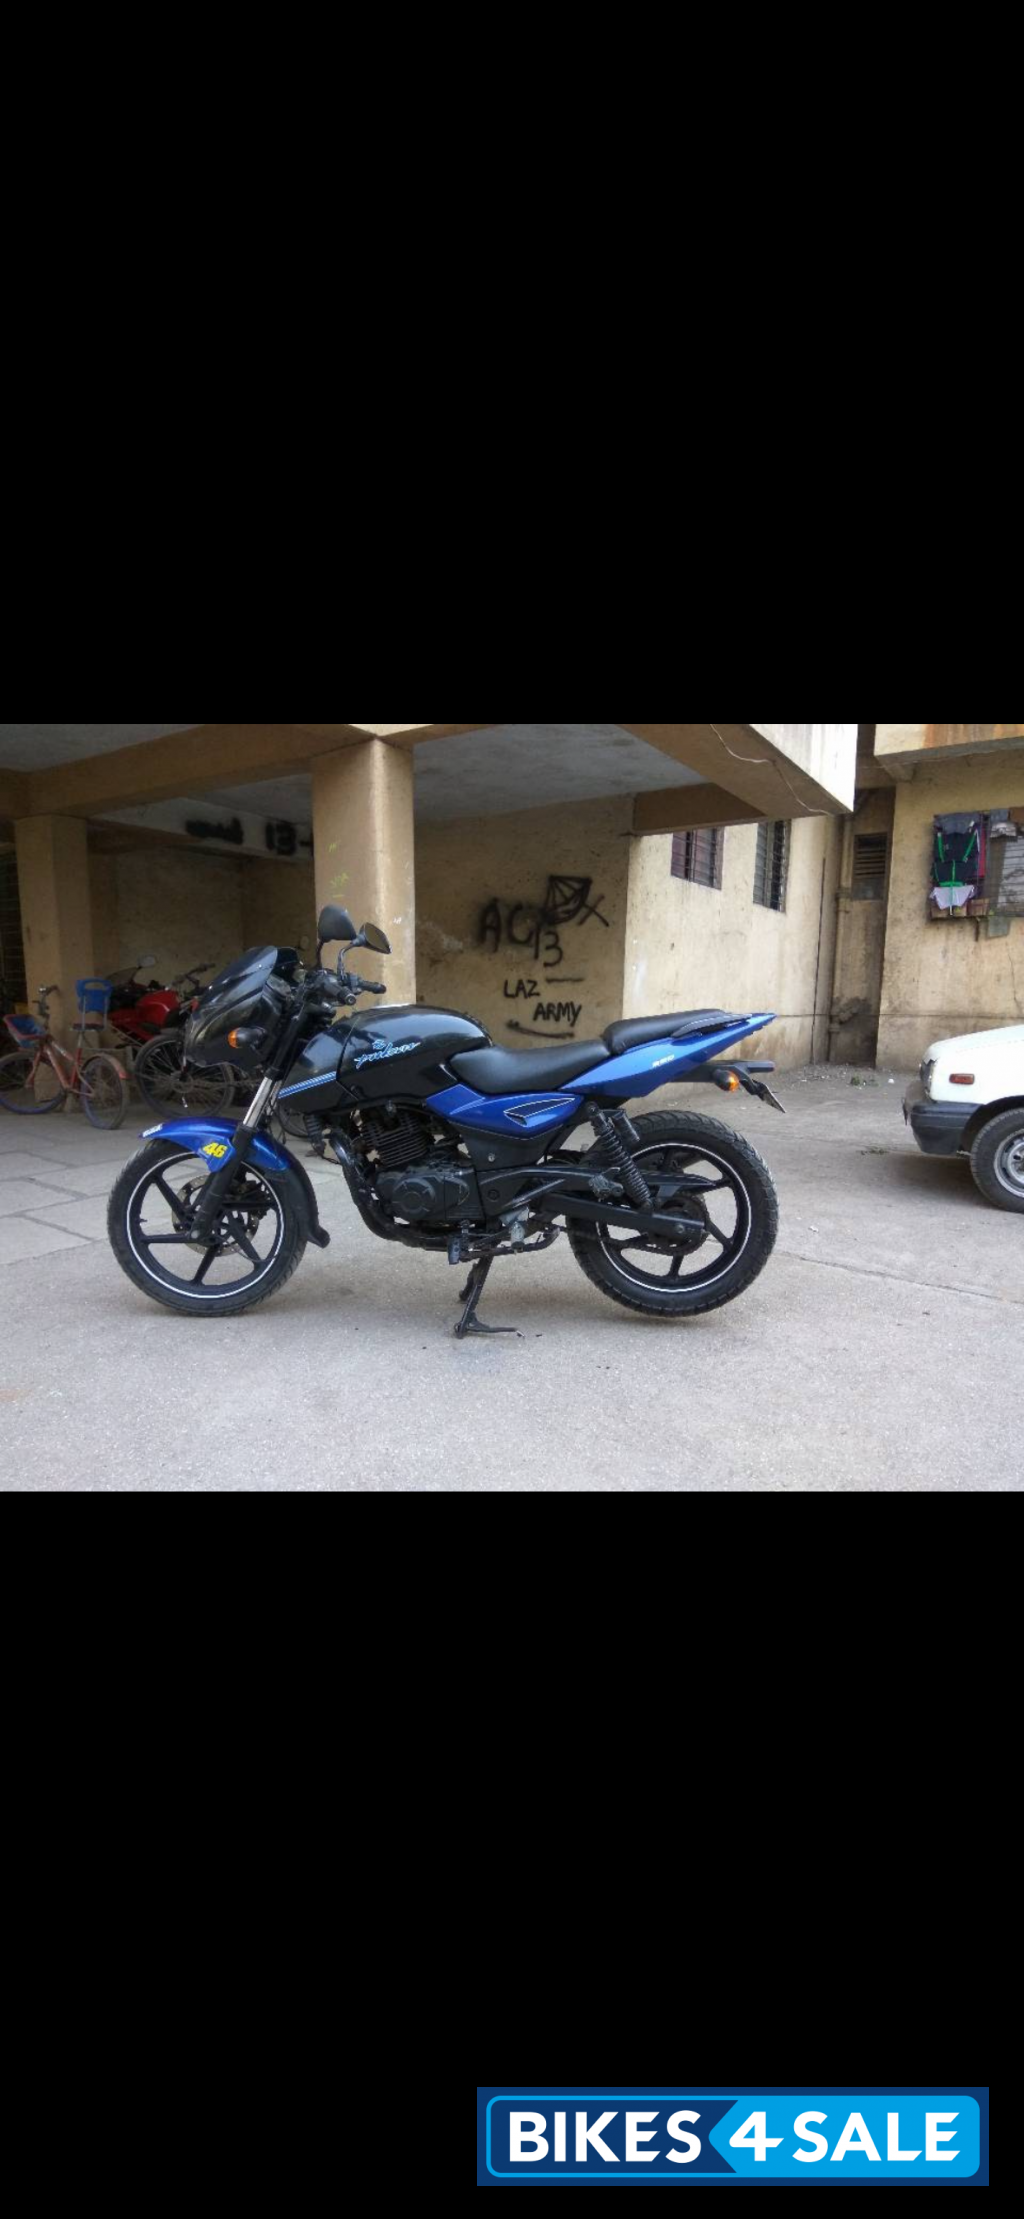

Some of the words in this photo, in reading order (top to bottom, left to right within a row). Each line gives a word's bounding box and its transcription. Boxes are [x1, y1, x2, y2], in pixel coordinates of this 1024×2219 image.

[503, 979, 540, 998] LAZ
[533, 1001, 581, 1027] ARMY
[203, 1142, 227, 1158] 46
